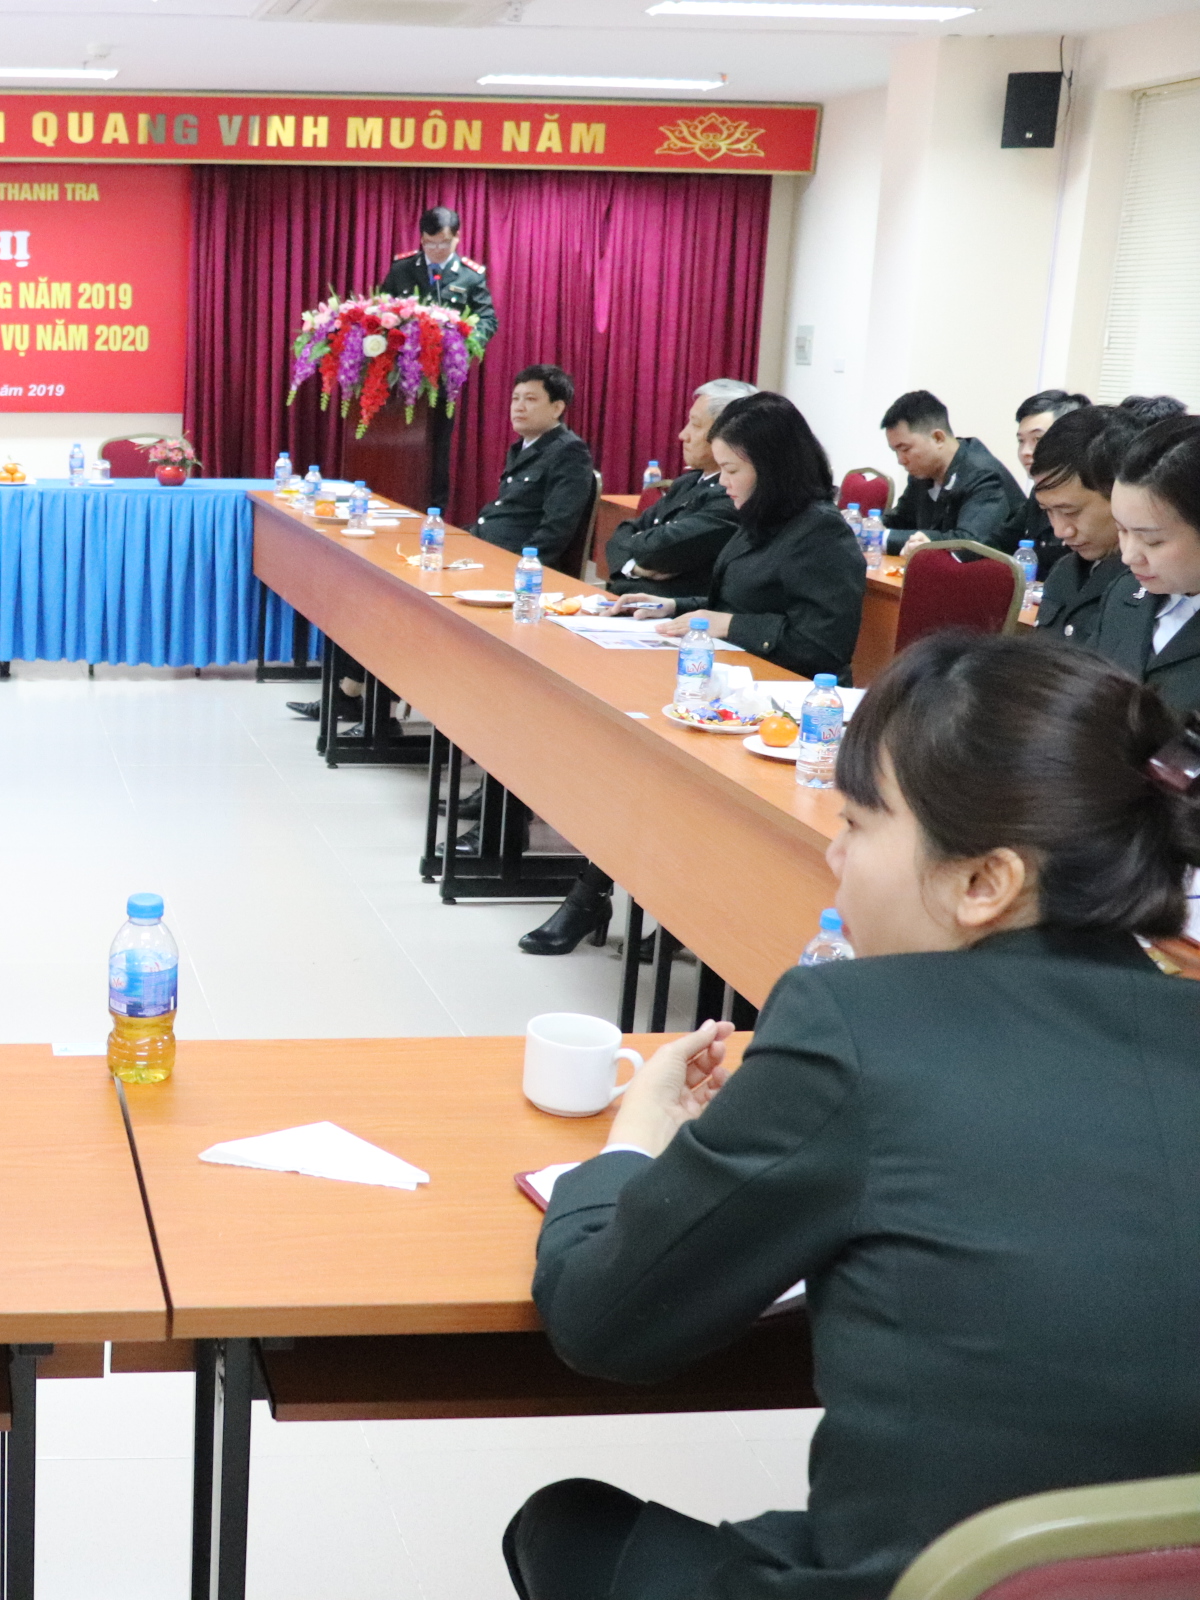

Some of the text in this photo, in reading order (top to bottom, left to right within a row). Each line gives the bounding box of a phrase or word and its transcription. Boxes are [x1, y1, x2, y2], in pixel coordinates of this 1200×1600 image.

[31, 111, 199, 147] QUANG
[218, 114, 329, 148] VINH
[346, 109, 482, 151] MUÔN
[501, 113, 607, 154] NĂM
[64, 183, 101, 202] TRA
[18, 276, 72, 310] NĂM
[77, 282, 133, 310] 2019
[0, 323, 31, 358] VỤ
[36, 319, 89, 352] NĂM
[94, 325, 150, 352] 2020
[27, 384, 66, 397] 2019
